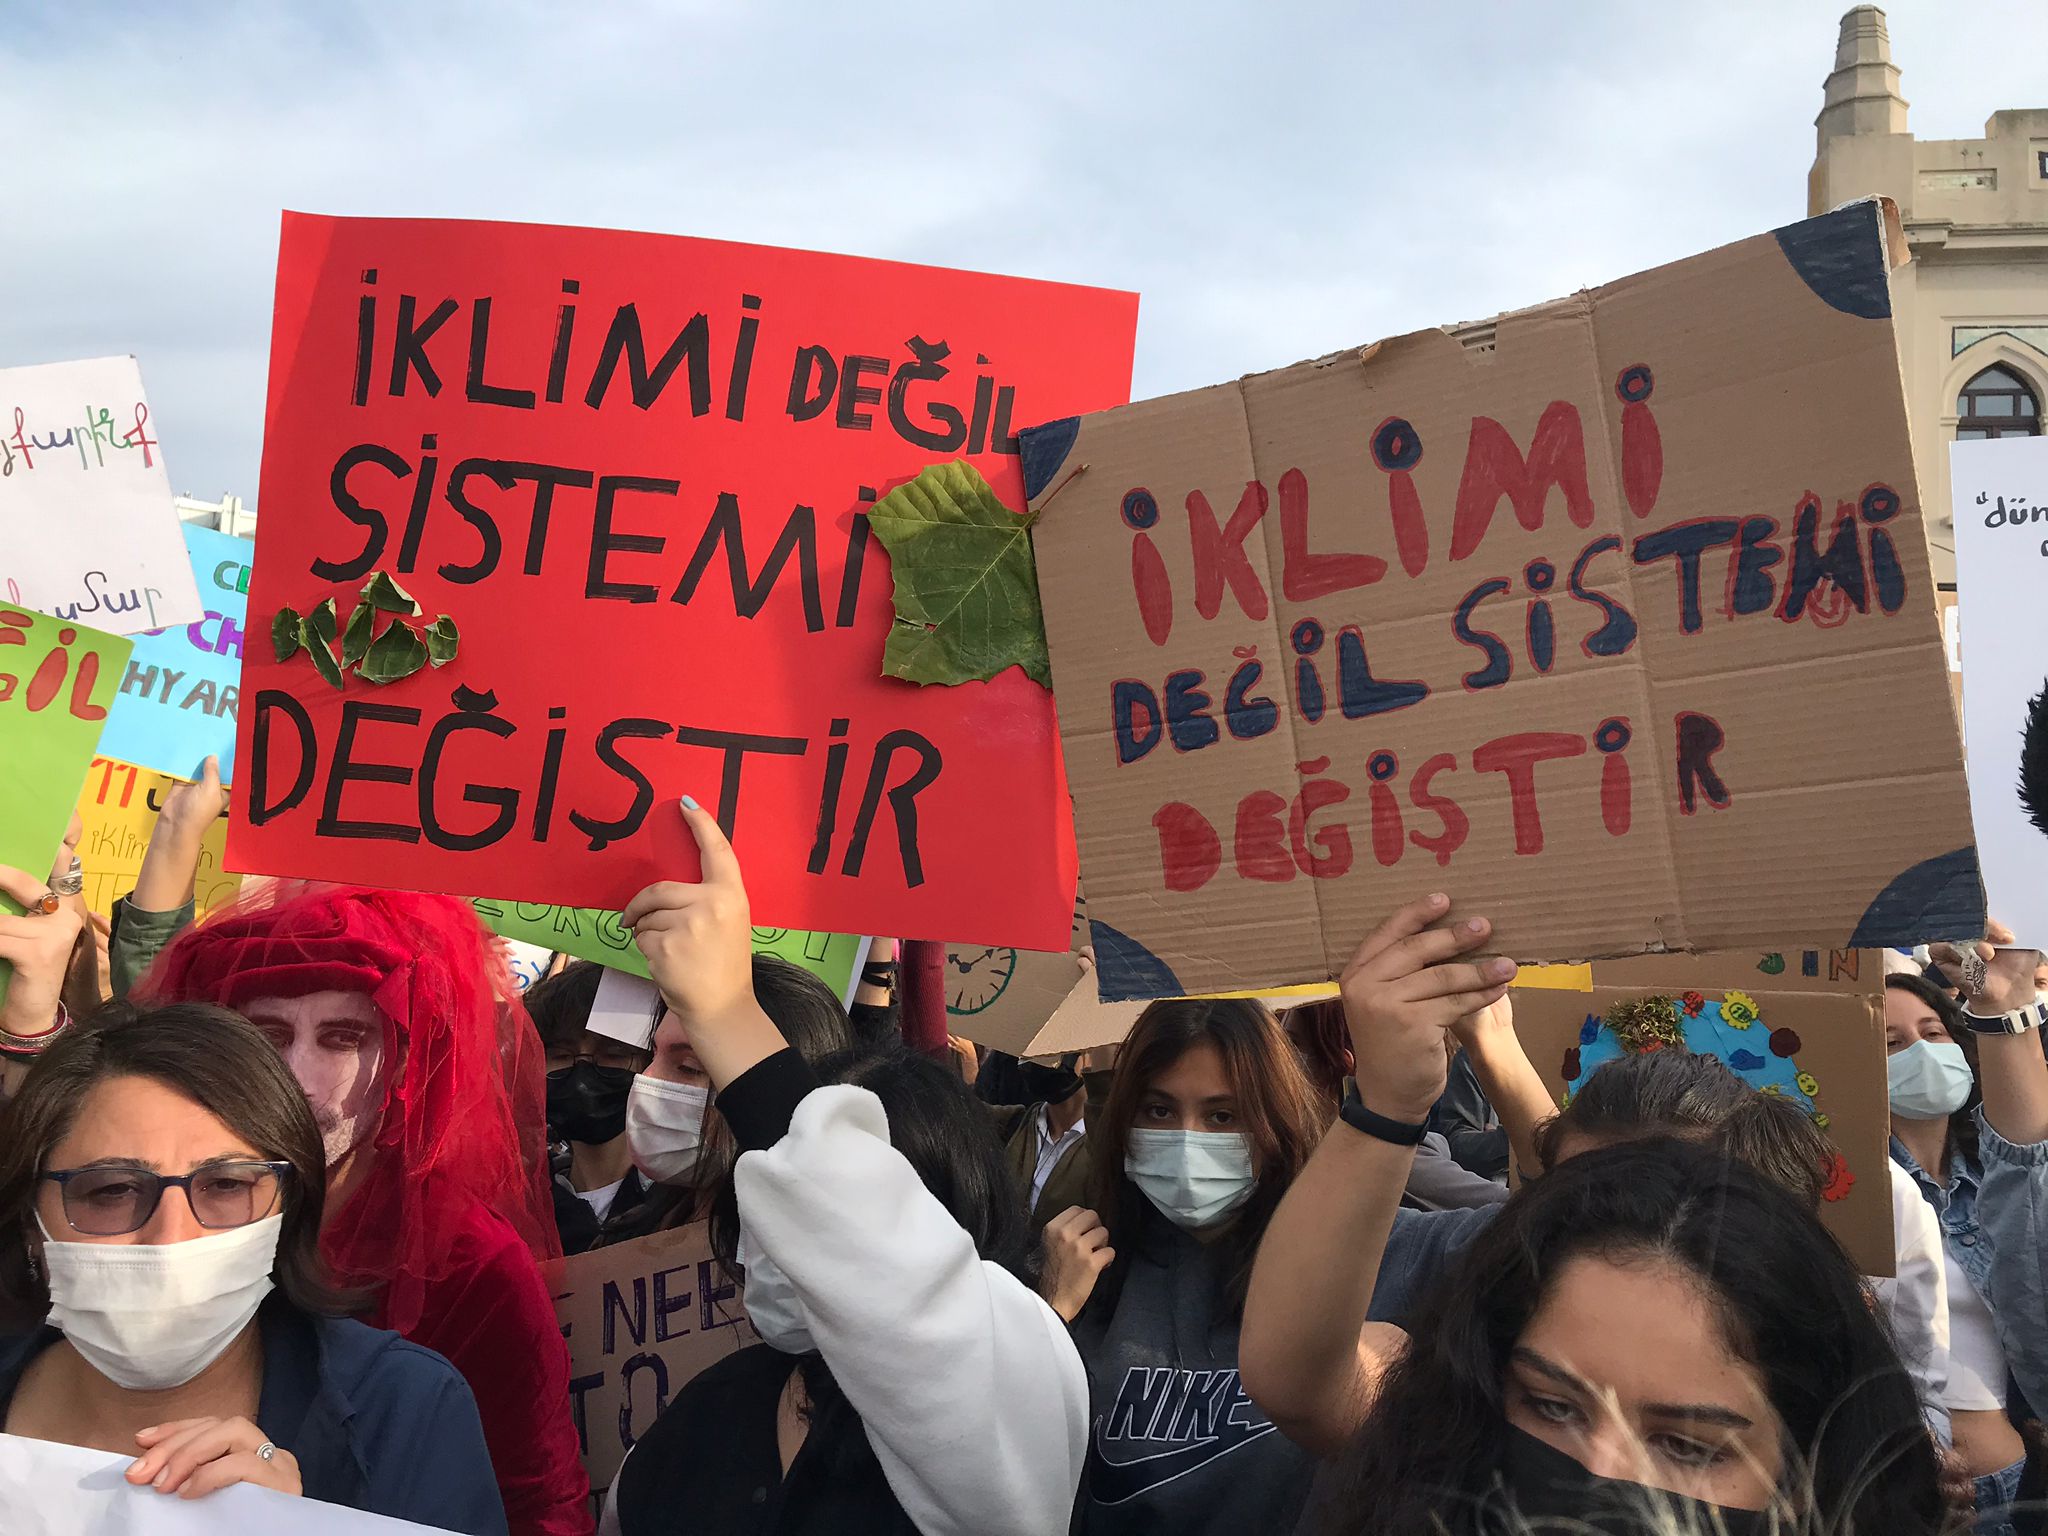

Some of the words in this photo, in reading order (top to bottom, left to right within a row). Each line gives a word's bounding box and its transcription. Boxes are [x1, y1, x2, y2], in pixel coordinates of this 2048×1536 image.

[351, 268, 763, 423] İKLİMİ
[786, 334, 1022, 456] DEĞİL
[310, 433, 878, 633] SİSTEMİ
[1120, 363, 1664, 647] İKLİMİ
[1110, 615, 1429, 767] DEĞİL
[1451, 482, 1909, 694] SİSTEMİ
[247, 683, 944, 889] DEĞİŞTİR
[1152, 711, 1732, 893] DEĞİŞTİR
[1106, 1366, 1273, 1442] NIKE
